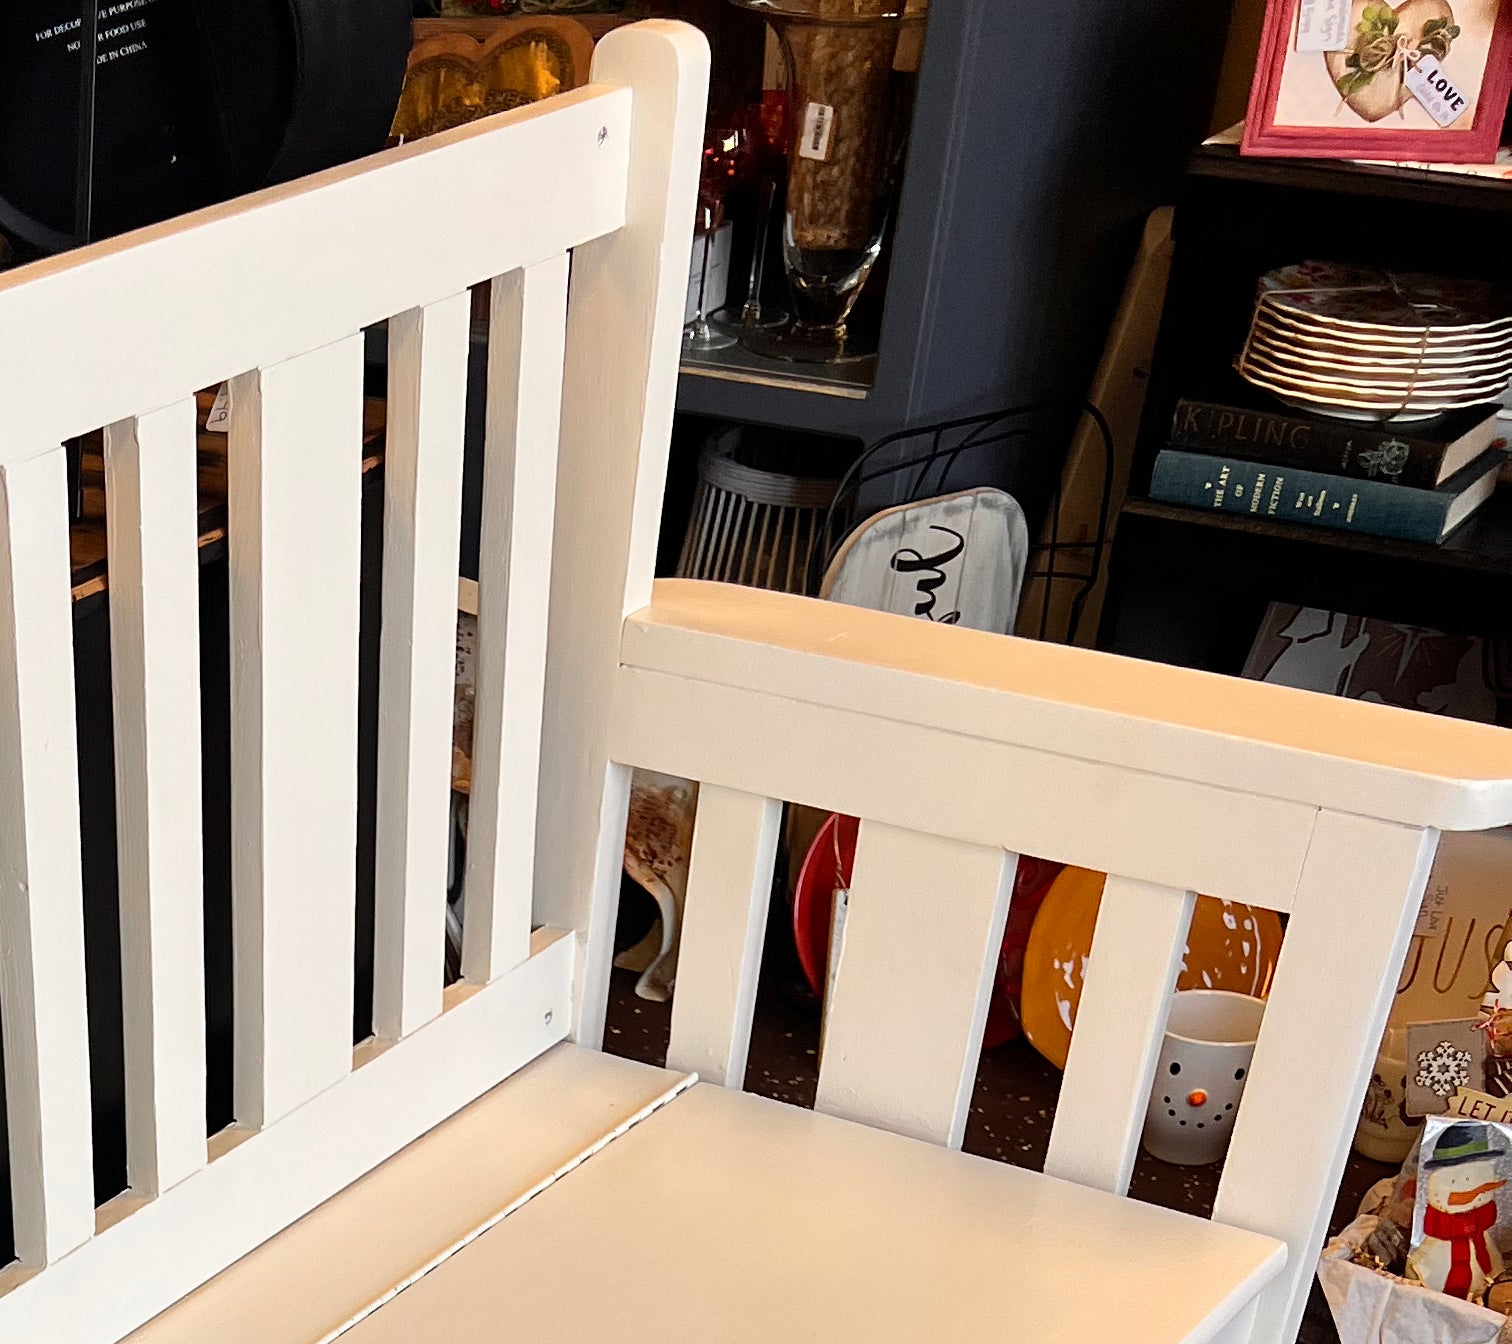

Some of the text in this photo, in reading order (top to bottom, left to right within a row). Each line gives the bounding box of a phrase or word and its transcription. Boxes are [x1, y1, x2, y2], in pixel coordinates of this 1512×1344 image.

[105, 24, 130, 39] FOOD
[129, 19, 148, 31] USE
[108, 49, 119, 60] IN
[119, 40, 148, 56] CHINA
[1427, 70, 1464, 111] LOVE
[1213, 465, 1231, 508] THE ART
[1249, 473, 1266, 513] MODERN
[1267, 476, 1284, 515] FICTION
[1457, 1096, 1496, 1121] LET
